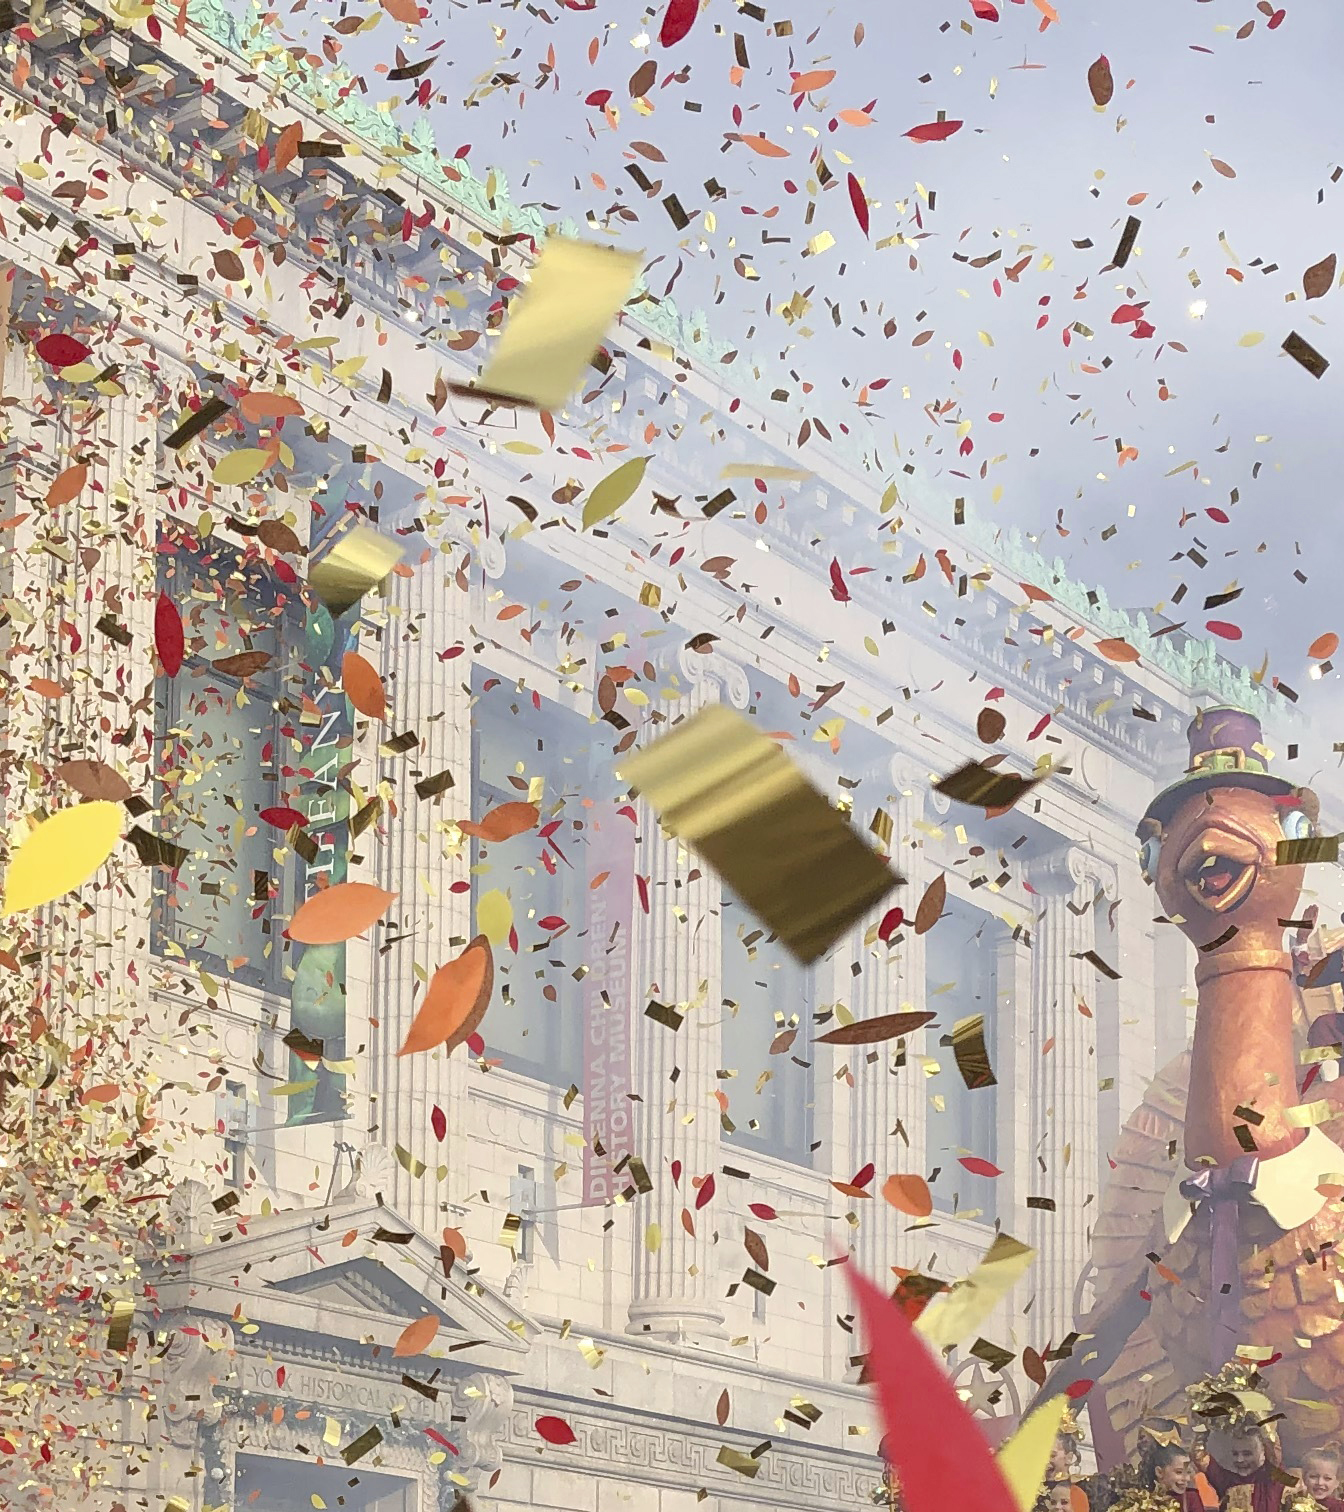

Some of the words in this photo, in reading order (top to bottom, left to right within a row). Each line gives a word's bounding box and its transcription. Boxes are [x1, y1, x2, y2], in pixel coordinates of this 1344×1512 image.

[304, 672, 344, 903] IFFANY
[590, 884, 606, 1047] CHILDREN'
[608, 929, 626, 1063] MUSEUM
